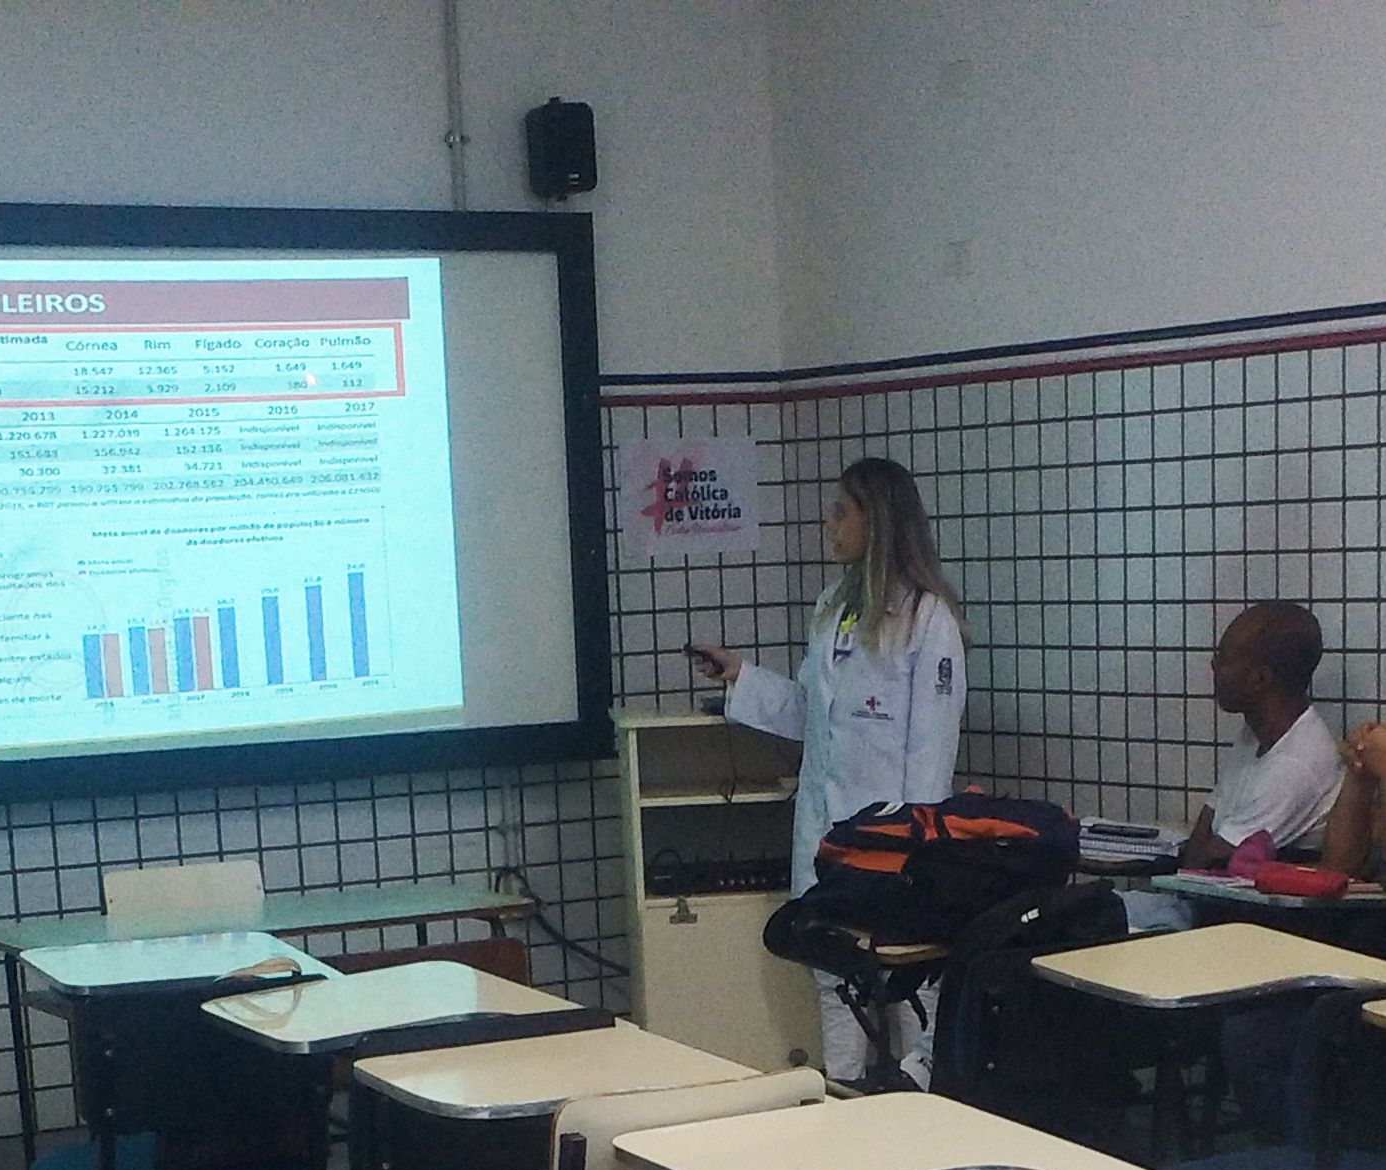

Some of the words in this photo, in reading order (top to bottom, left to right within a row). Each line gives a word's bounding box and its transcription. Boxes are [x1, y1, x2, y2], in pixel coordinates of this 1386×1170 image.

[65, 339, 119, 352] Córnea
[143, 339, 171, 351] Rim
[195, 338, 242, 352] Fígado
[254, 336, 311, 350] Coração
[320, 335, 372, 347] Pulmão
[138, 365, 179, 375] 12.365
[275, 361, 307, 372] 1.649
[187, 408, 220, 418] 2015
[267, 405, 299, 415] 2016
[344, 402, 376, 413] 2017
[21, 411, 56, 422] 2013
[106, 410, 138, 420] 2014
[664, 468, 718, 483] Somos
[664, 484, 730, 502] Católica
[664, 505, 685, 522] de
[688, 503, 743, 521] Vitória
